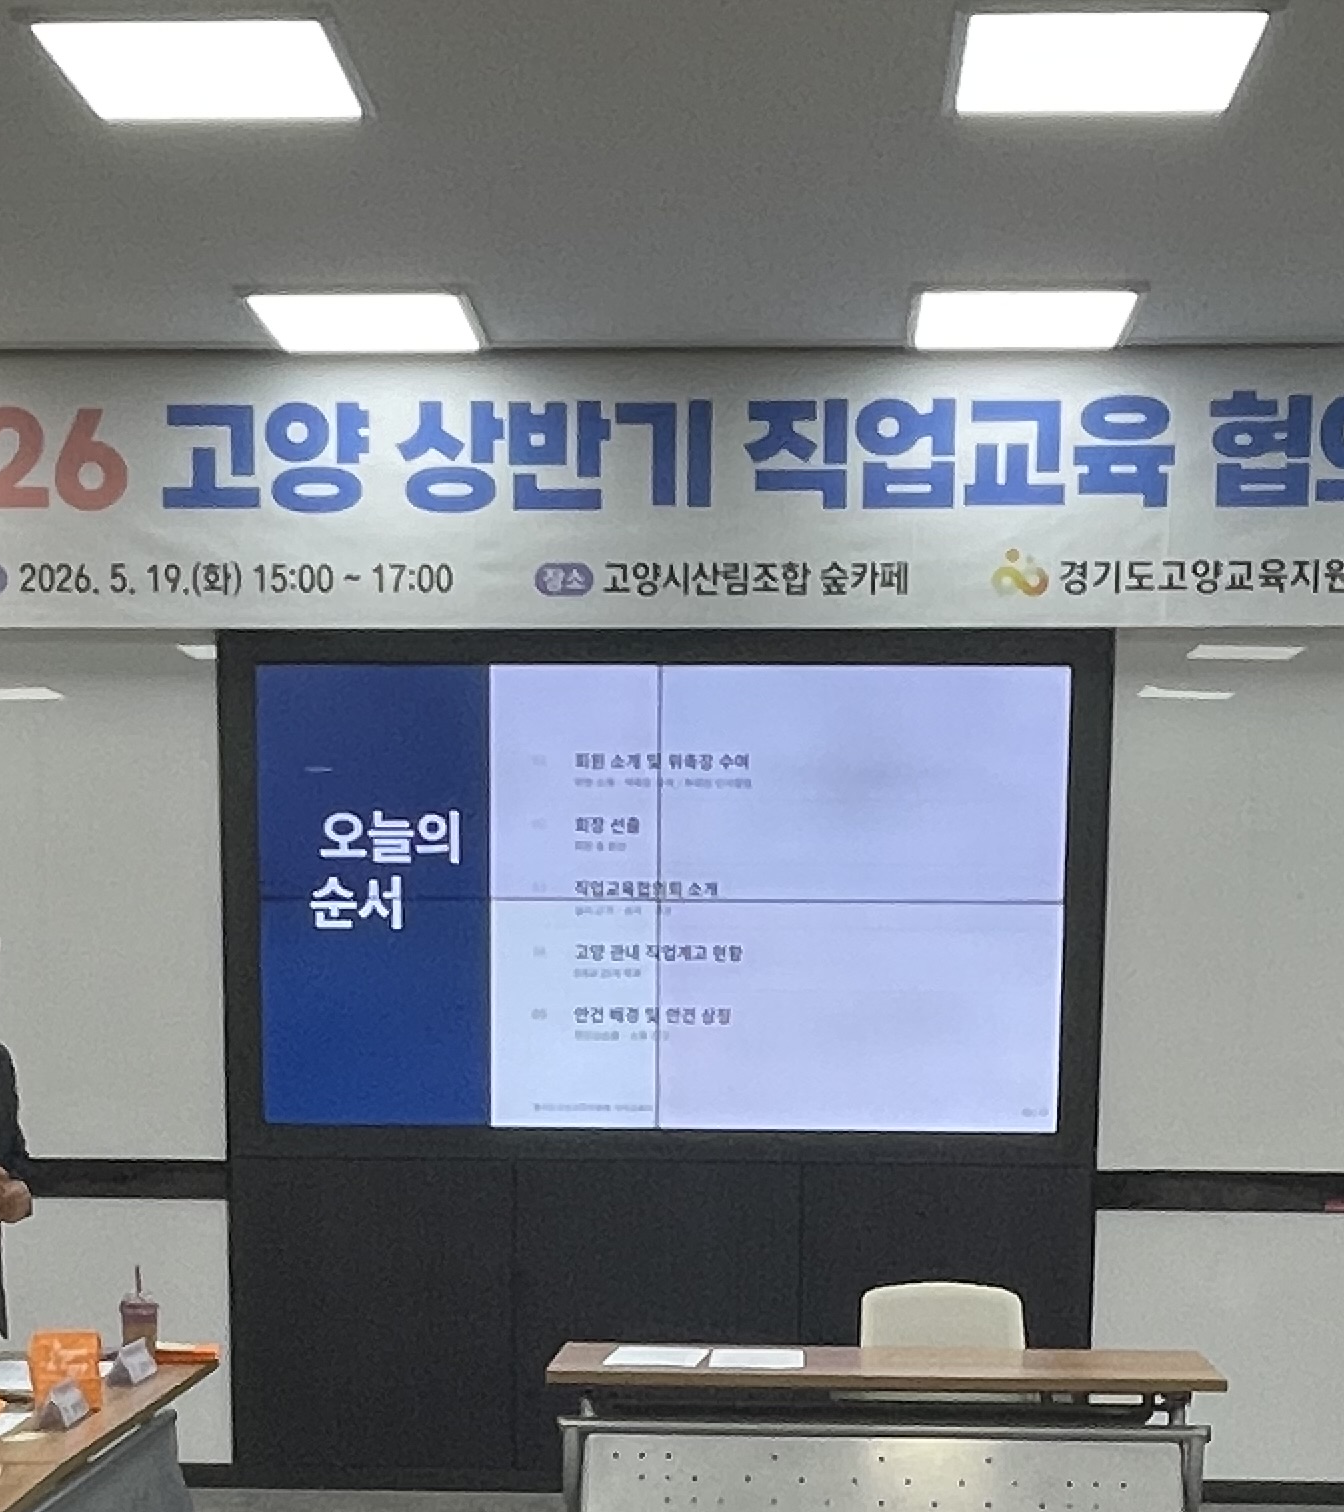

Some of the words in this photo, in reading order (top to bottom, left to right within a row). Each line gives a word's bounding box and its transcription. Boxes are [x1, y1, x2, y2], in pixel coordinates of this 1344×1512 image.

[162, 400, 371, 514] 고양
[397, 400, 713, 514] 상반기
[743, 396, 1177, 510] 직업교육
[19, 563, 100, 595] 2026.
[110, 563, 137, 595] 5.
[254, 563, 334, 595] 15:00
[372, 562, 454, 595] 17:00
[543, 568, 586, 592] 장소
[603, 560, 812, 597] 고양시산림조합
[820, 560, 909, 597] 숲카페
[610, 753, 641, 770] 소개
[319, 810, 461, 866] 오늘의
[574, 817, 604, 834] 회장
[687, 881, 718, 897] 소개
[309, 875, 403, 930] 순서
[574, 945, 605, 961] 고양
[610, 945, 640, 961] 관내
[573, 1007, 604, 1024] 안건
[666, 1007, 696, 1024] 안건
